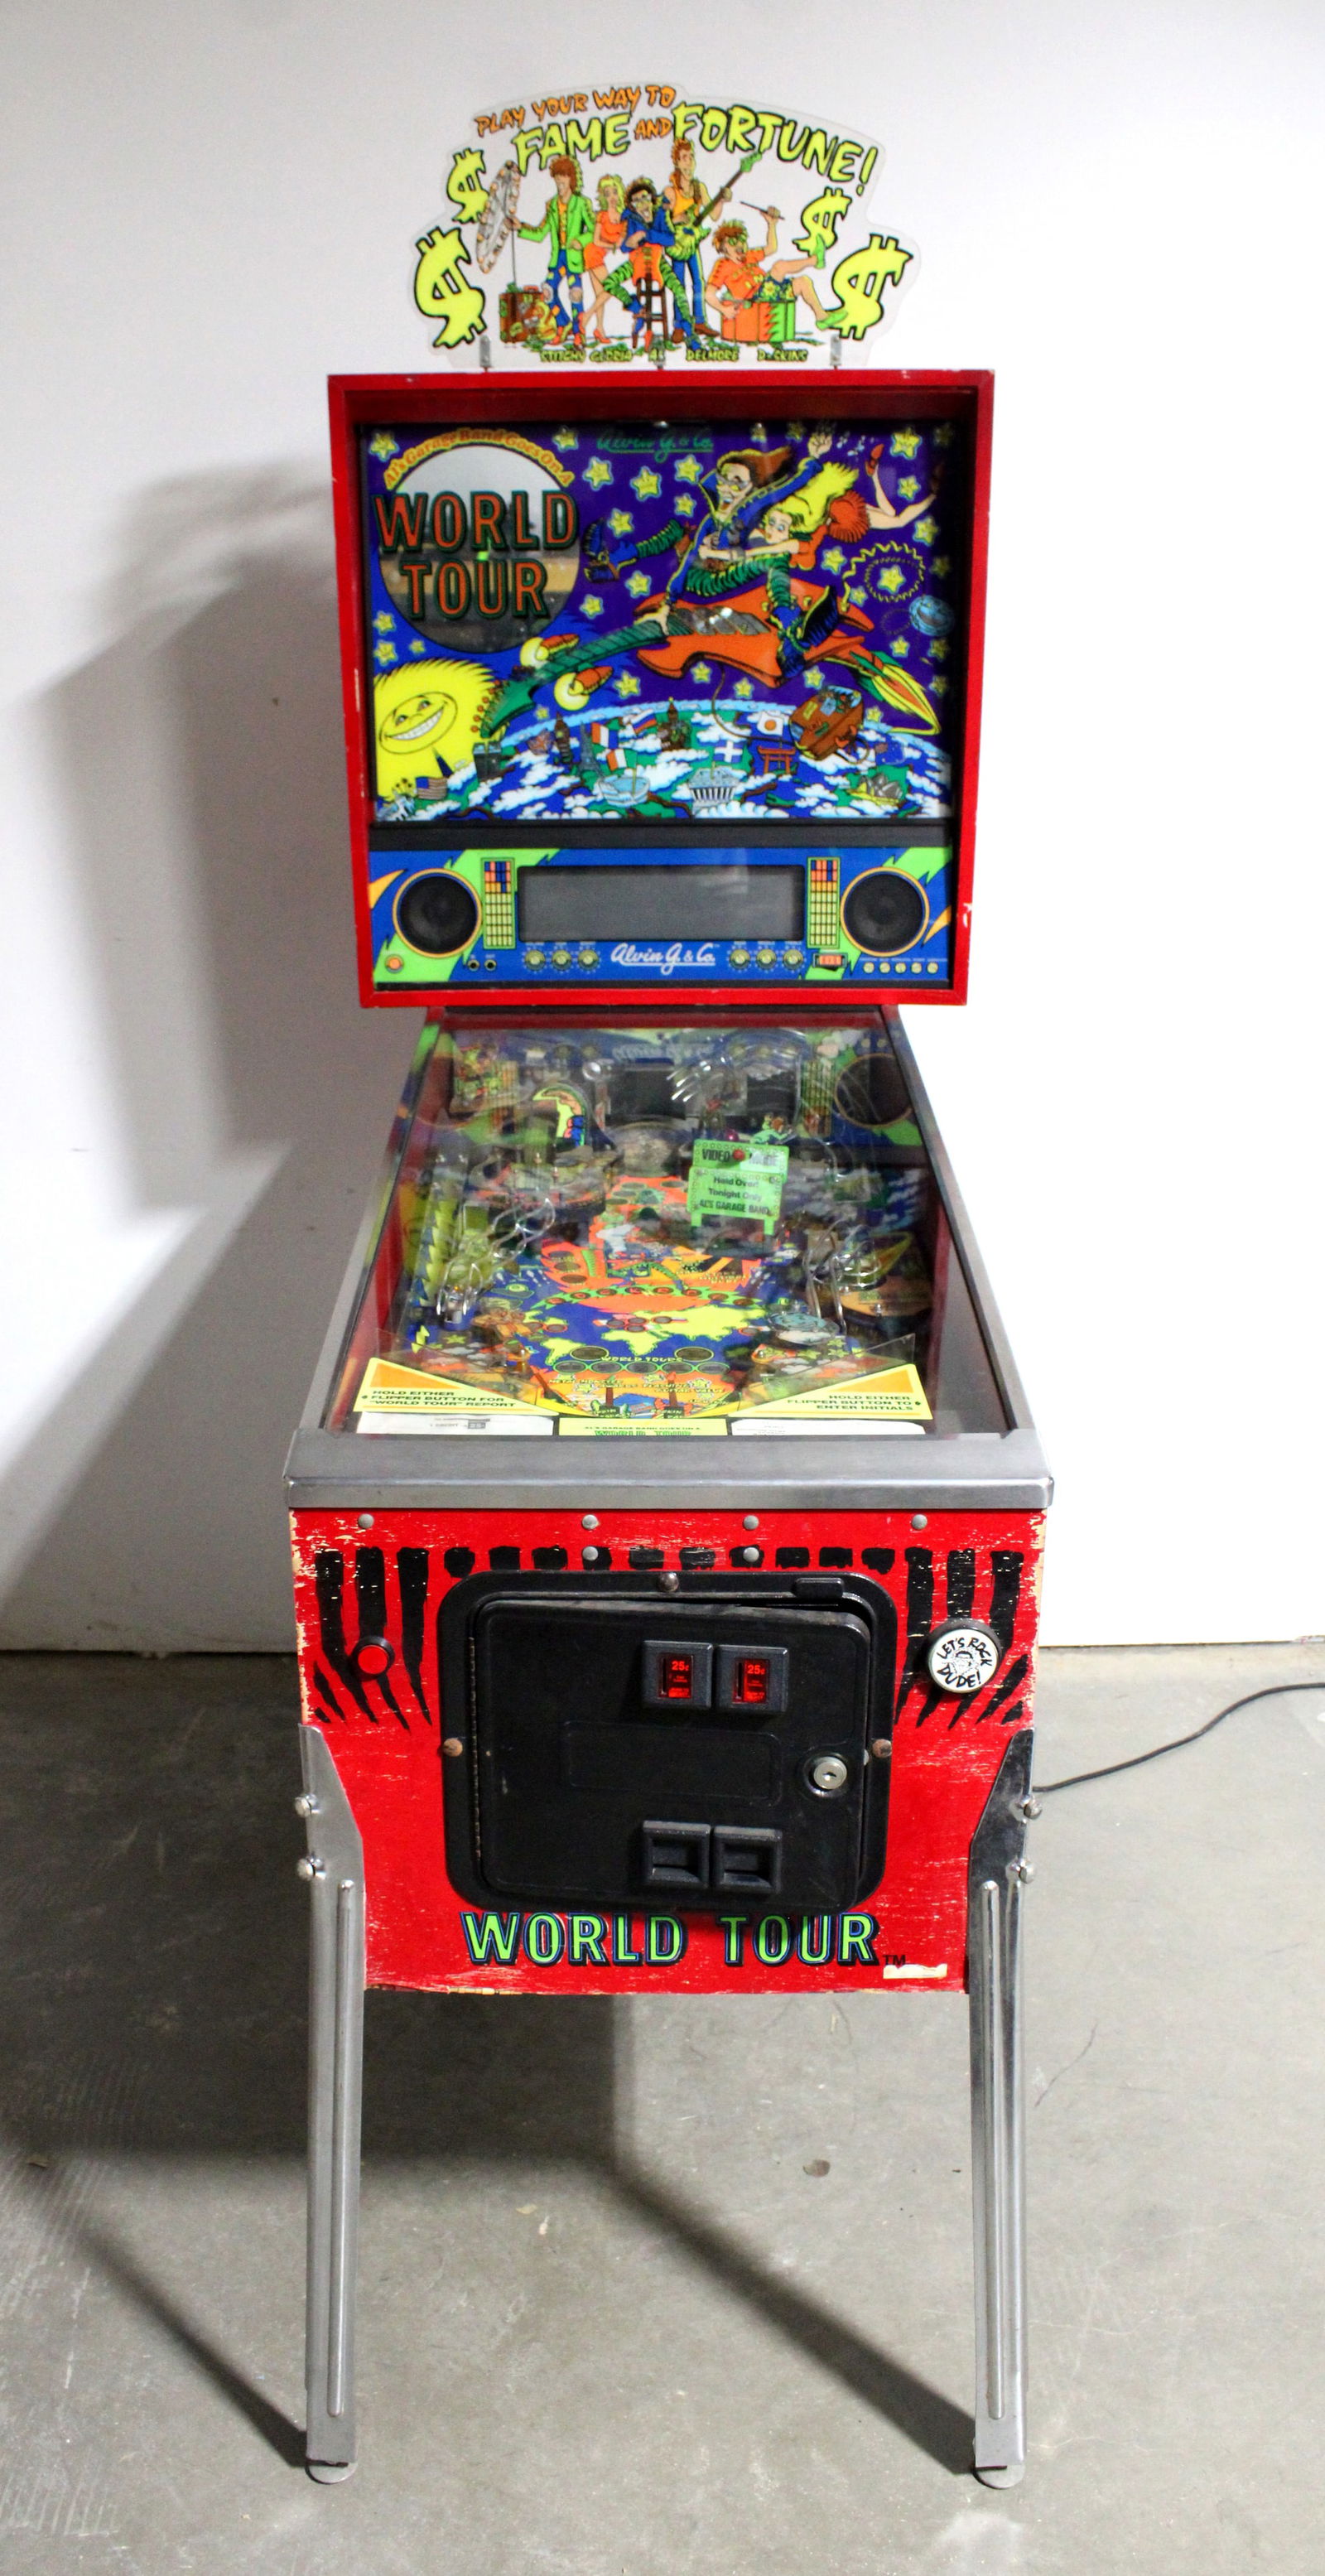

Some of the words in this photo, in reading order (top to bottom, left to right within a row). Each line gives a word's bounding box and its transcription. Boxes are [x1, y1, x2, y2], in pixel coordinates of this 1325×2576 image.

[474, 106, 526, 137] PLAY
[531, 93, 589, 122] YOUR
[592, 86, 641, 113] WAY
[644, 84, 677, 108] TO
[510, 113, 632, 176] FAME
[634, 118, 672, 140] AND
[672, 101, 878, 197] FORTUNE!
[373, 490, 578, 553] WORLD
[399, 557, 551, 620] TOUR
[610, 942, 664, 963] Alvin
[683, 949, 694, 962] &
[701, 1149, 731, 1163] VIDEO
[708, 1187, 741, 1199] Tonight
[715, 1200, 746, 1213] GARAGE
[936, 1637, 966, 1659] LET'S
[936, 1662, 982, 1688] DUDE!
[460, 1912, 689, 1967] WORLD
[717, 1912, 884, 1967] TOUR
